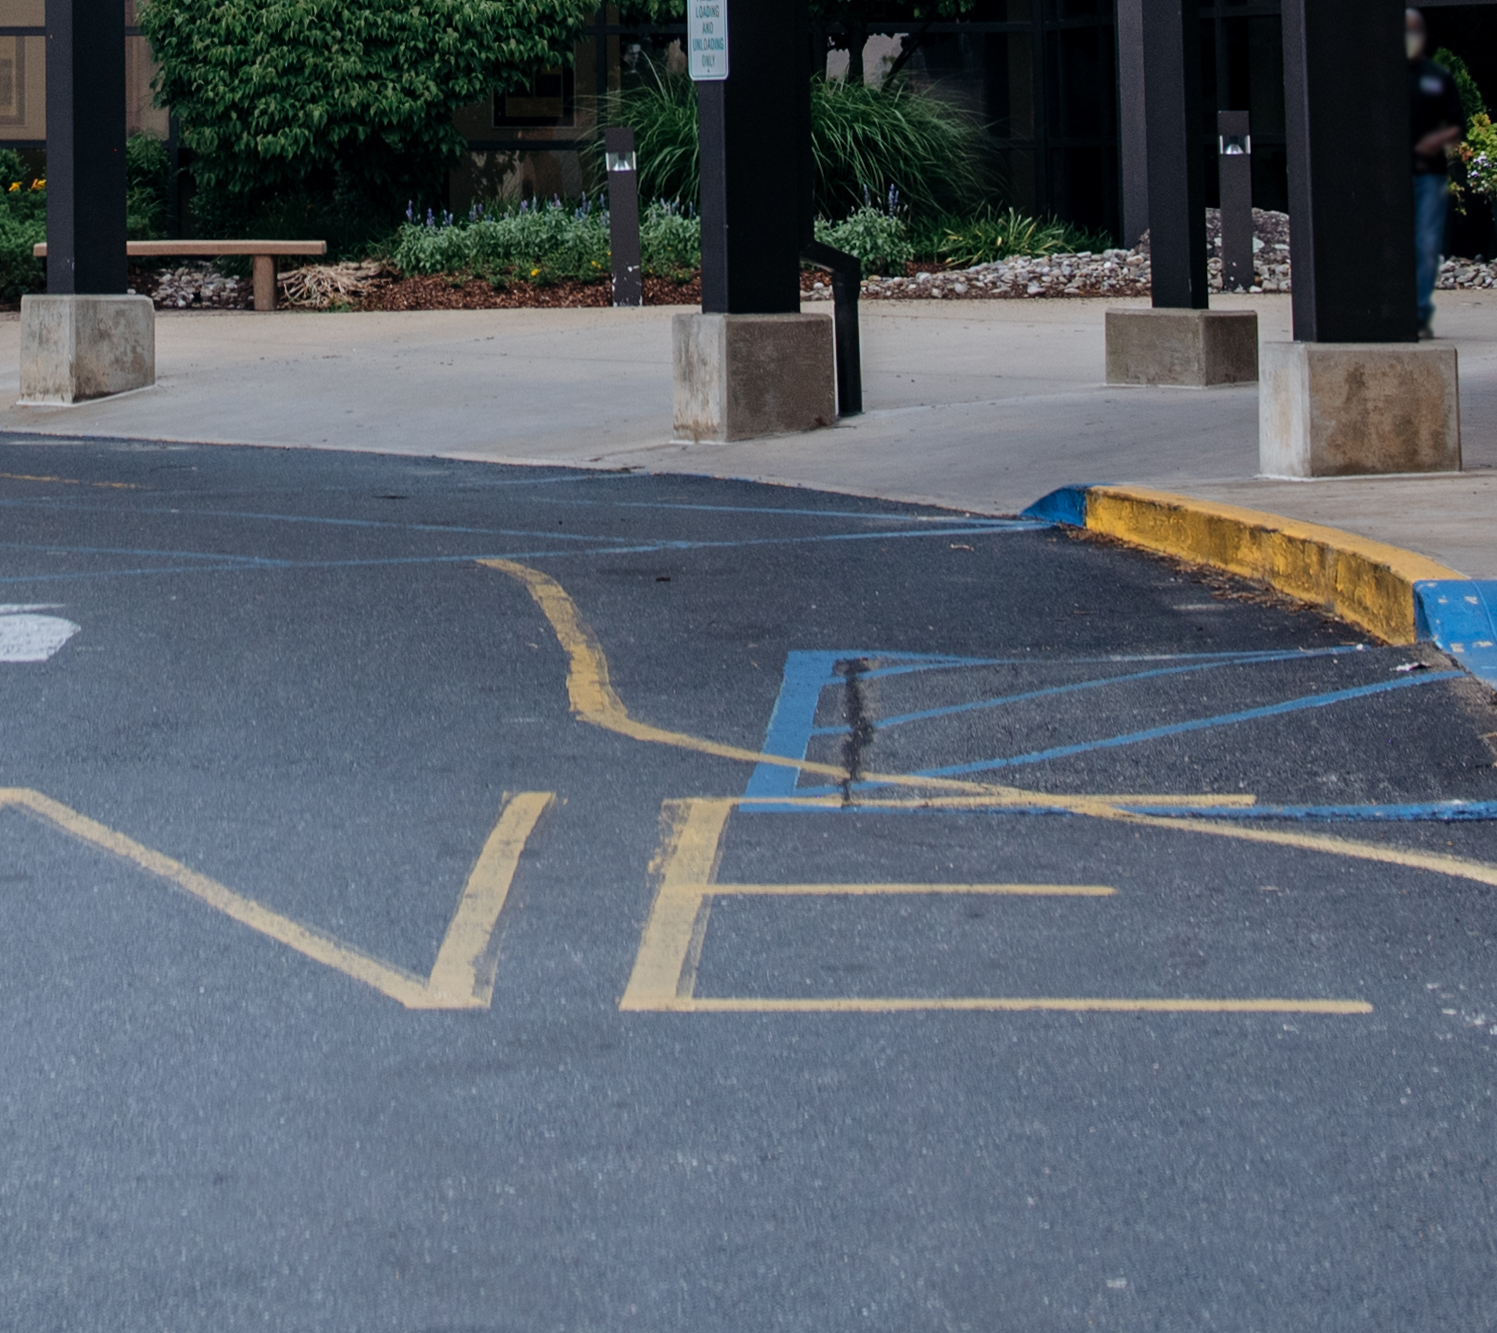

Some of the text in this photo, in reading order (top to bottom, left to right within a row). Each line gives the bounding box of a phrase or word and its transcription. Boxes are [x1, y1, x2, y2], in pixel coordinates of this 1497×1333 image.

[695, 5, 720, 19] LOADING
[702, 22, 714, 34] AND
[692, 37, 724, 51] UNLOADING
[701, 54, 716, 68] ONLY
